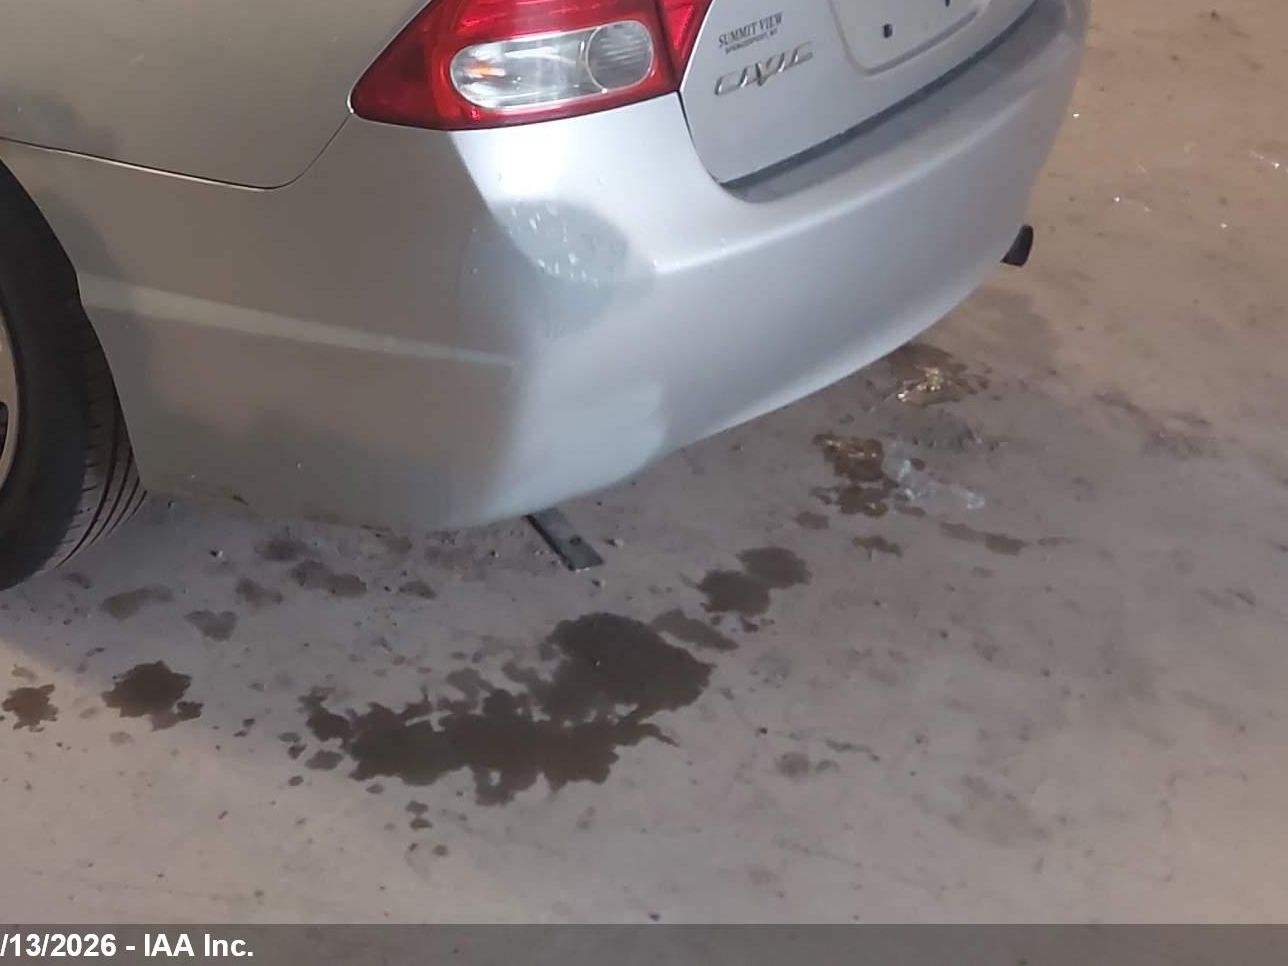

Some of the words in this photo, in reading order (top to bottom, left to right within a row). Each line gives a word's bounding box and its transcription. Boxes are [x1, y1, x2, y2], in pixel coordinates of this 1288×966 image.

[718, 21, 758, 48] SUMMIT
[759, 11, 784, 31] VIEW
[714, 41, 814, 96] CIVIC
